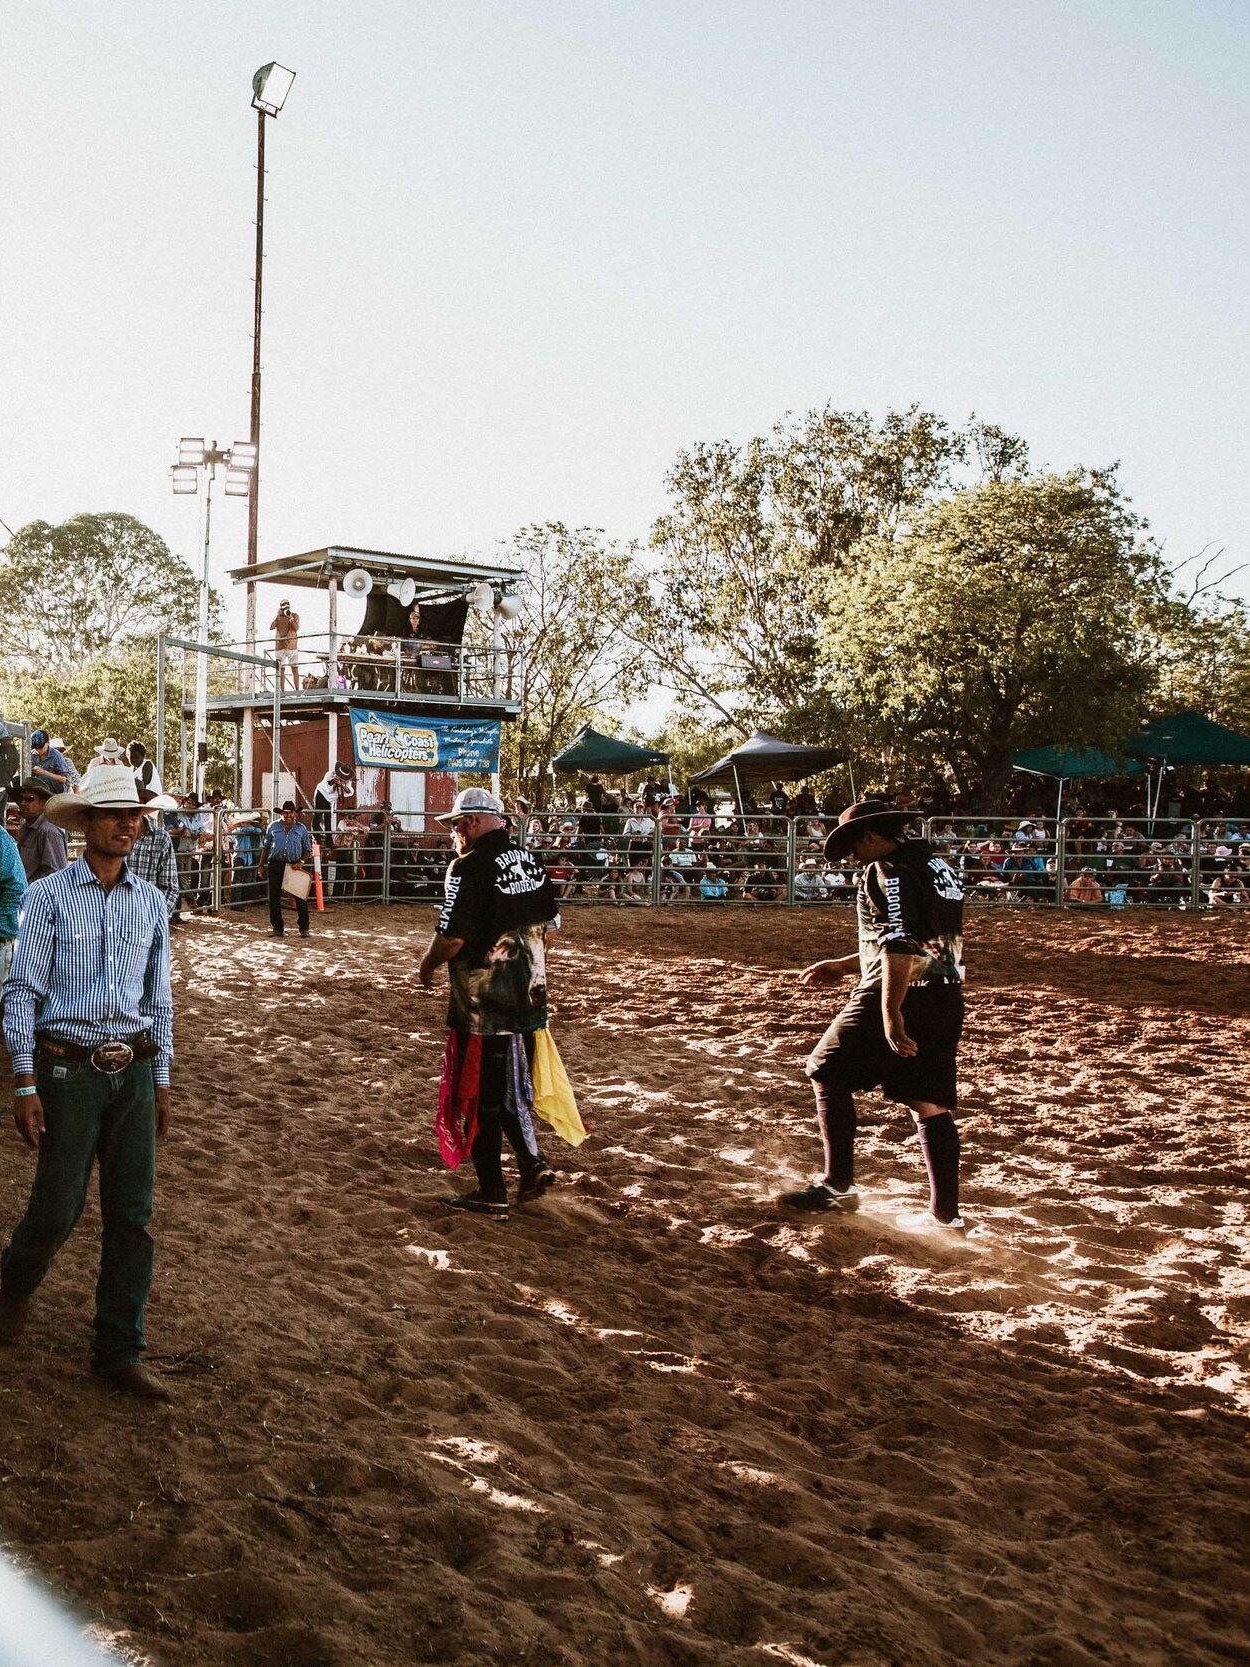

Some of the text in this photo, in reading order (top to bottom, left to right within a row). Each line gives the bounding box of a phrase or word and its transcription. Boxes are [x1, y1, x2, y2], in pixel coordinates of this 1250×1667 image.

[360, 728, 434, 748] Pearl Coast
[369, 743, 429, 762] Helicopters
[458, 747, 480, 758] Phone
[495, 849, 536, 870] BROOME
[509, 878, 537, 895] RODEO
[440, 876, 462, 931] BROOME
[884, 877, 903, 930] BROOME
